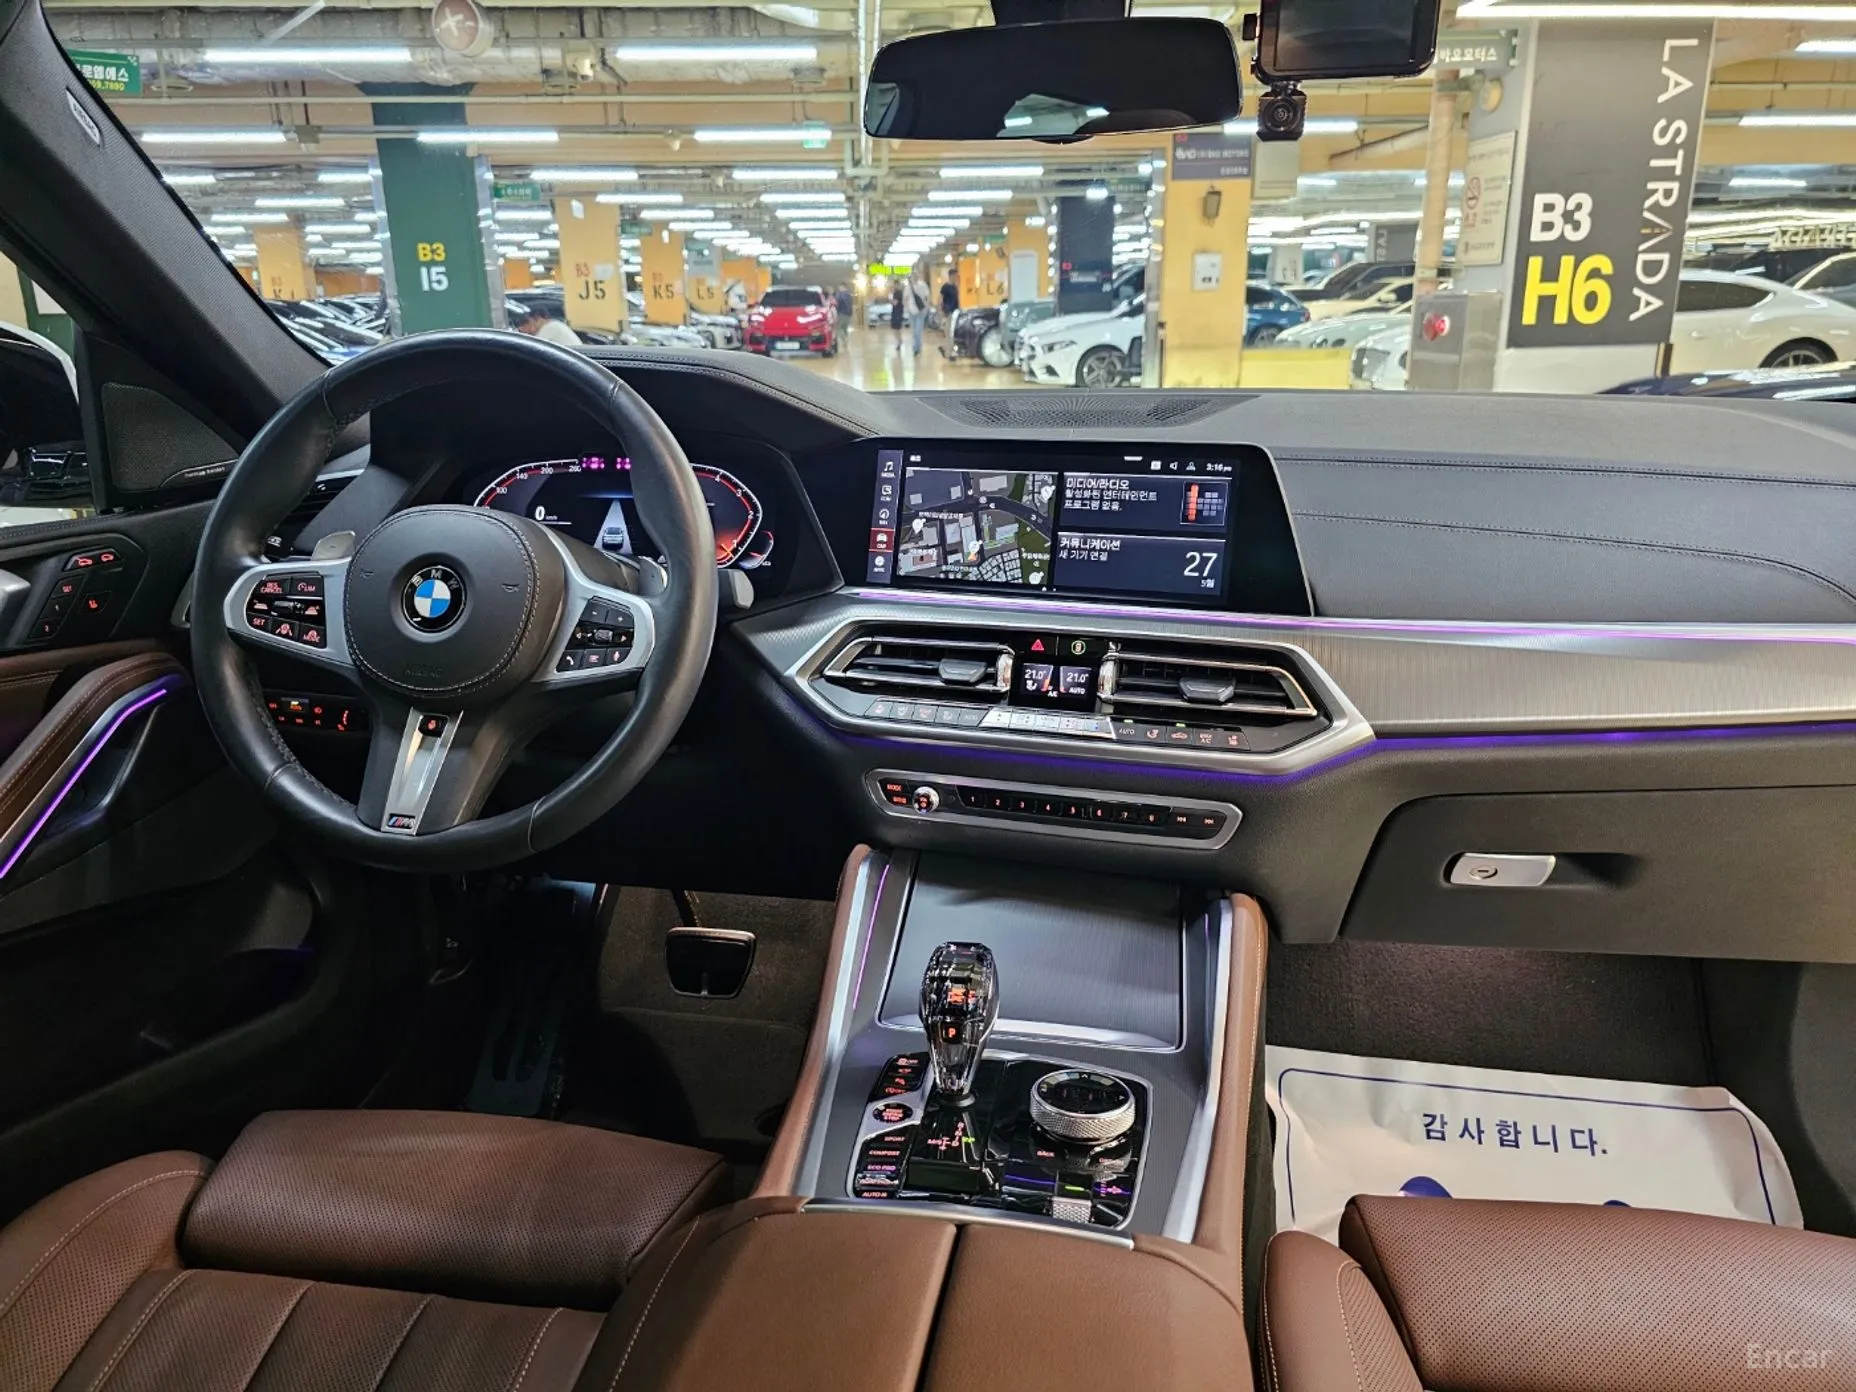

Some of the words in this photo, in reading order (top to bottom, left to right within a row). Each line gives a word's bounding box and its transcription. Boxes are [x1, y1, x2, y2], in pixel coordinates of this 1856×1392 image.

[1657, 38, 1699, 103] LA
[1529, 192, 1593, 242] B3
[1628, 118, 1688, 322] STRADA
[416, 242, 446, 262] B3
[578, 280, 606, 300] J5
[1521, 253, 1614, 325] H6
[535, 505, 546, 521] 0
[1059, 536, 1121, 551] 커뮤니케이션
[1183, 551, 1218, 577] 27
[411, 568, 460, 590] BMW
[1068, 687, 1086, 695] AUTO
[948, 1027, 956, 1038] P
[1421, 1112, 1608, 1158] 감사합니다.
